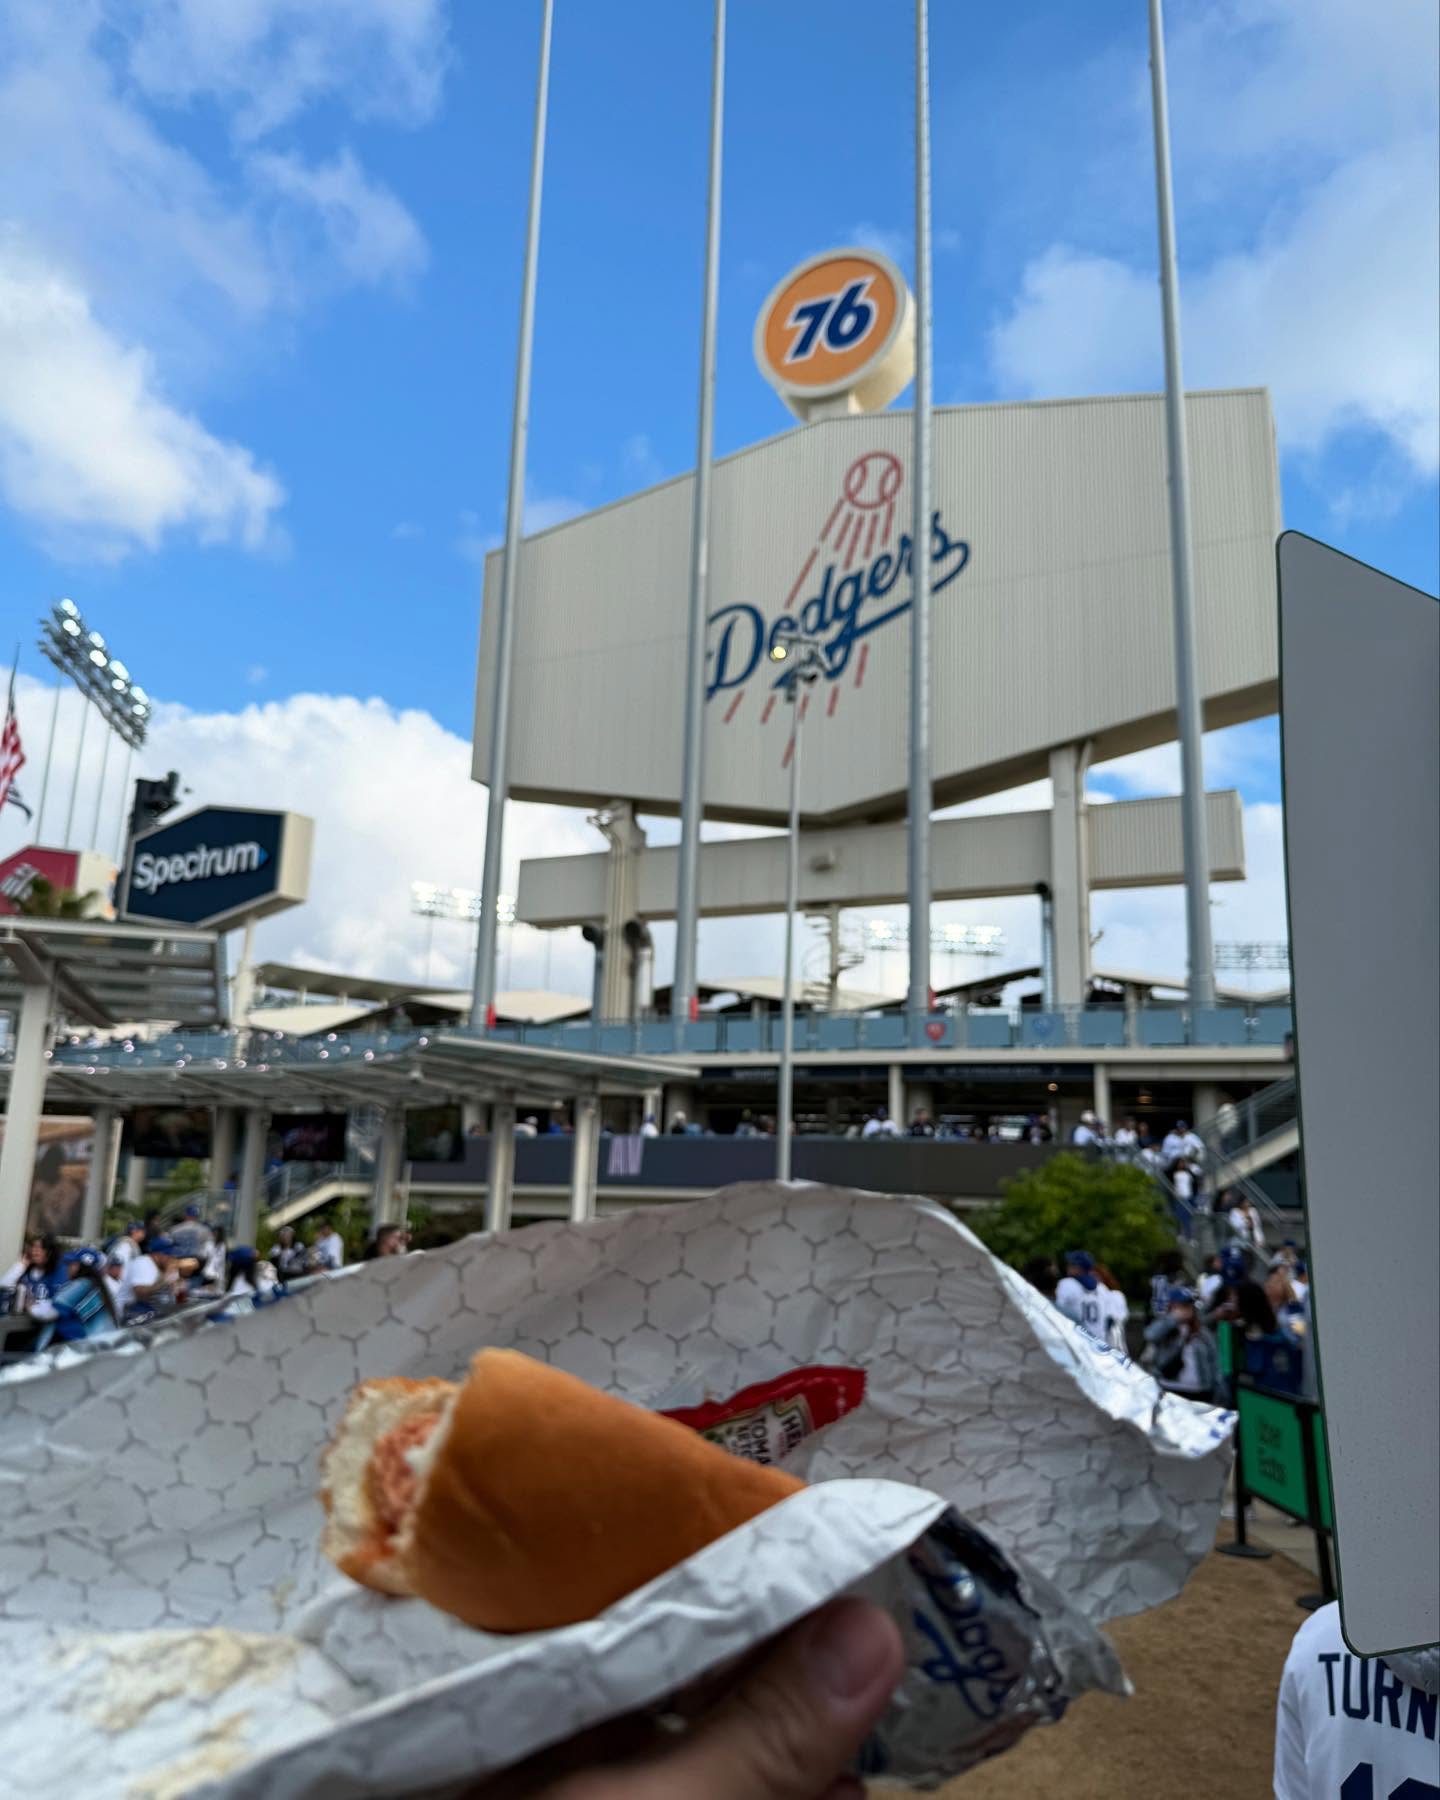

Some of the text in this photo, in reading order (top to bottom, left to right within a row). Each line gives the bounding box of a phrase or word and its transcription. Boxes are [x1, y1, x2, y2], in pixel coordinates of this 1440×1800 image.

[786, 276, 876, 362] 76
[706, 510, 971, 702] Dodgers
[132, 841, 260, 894] Spectrum
